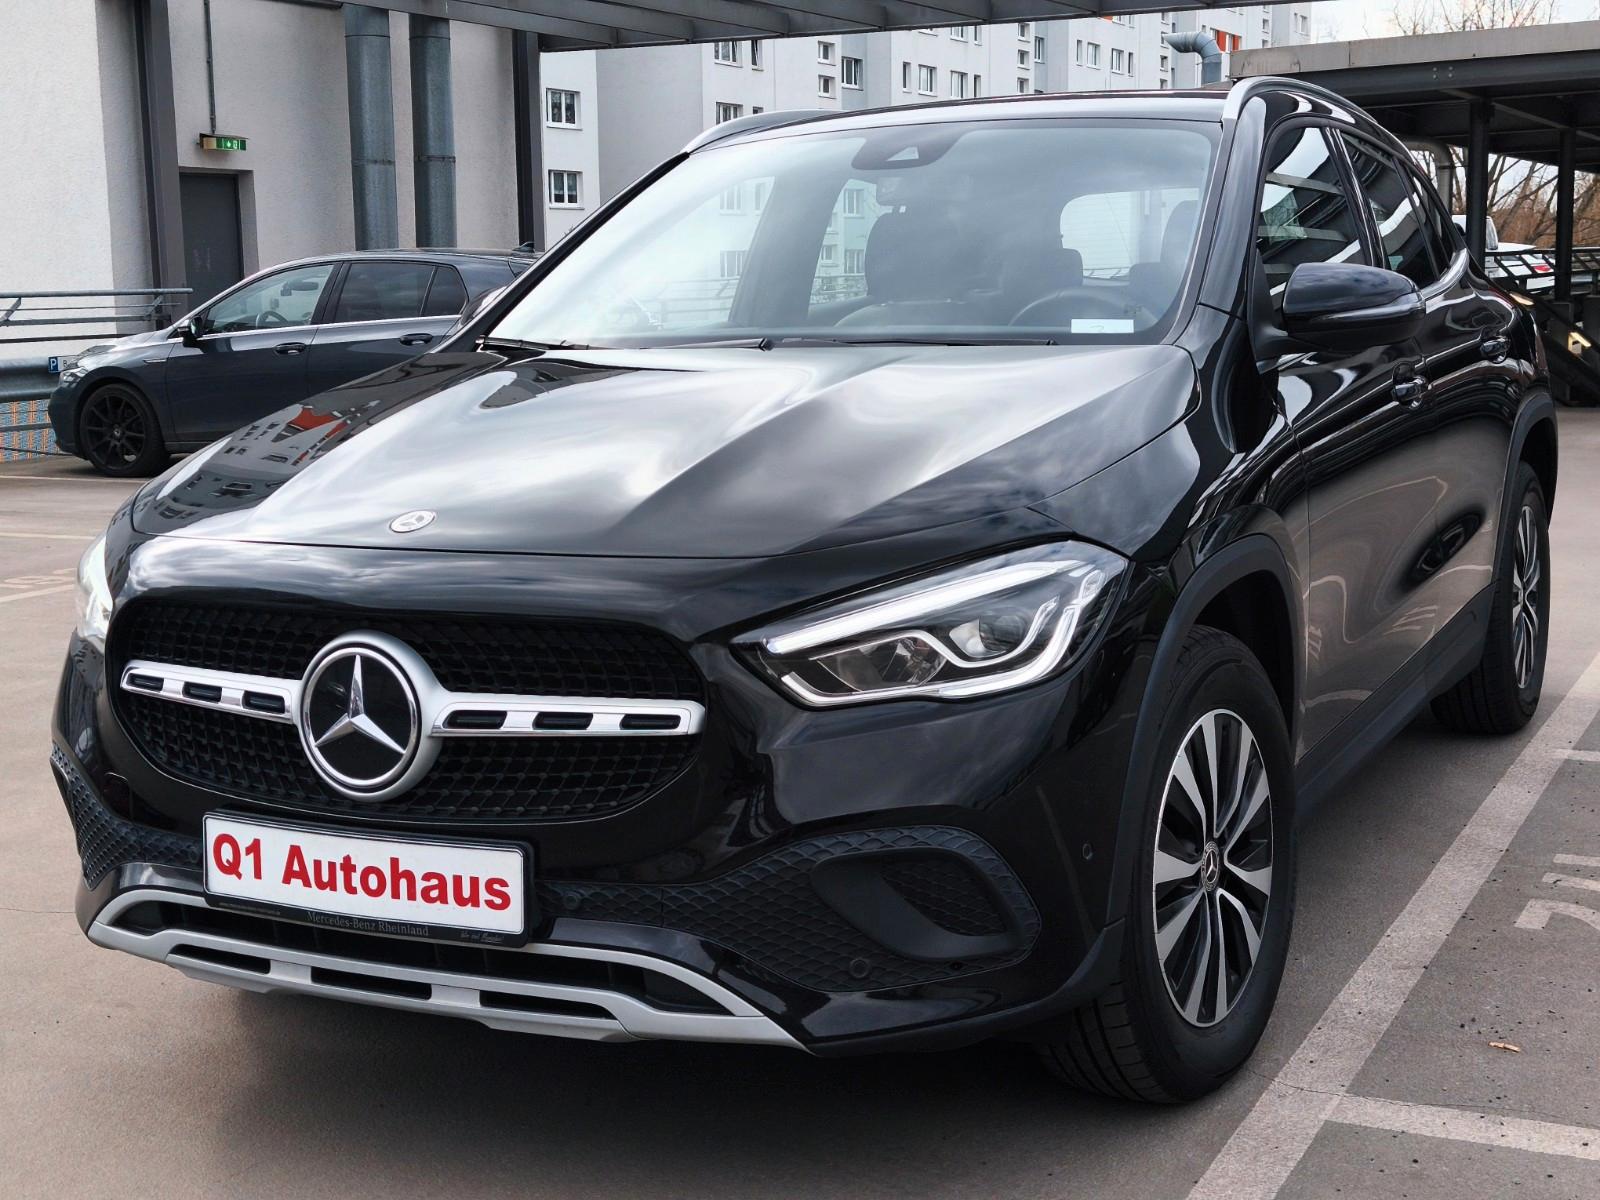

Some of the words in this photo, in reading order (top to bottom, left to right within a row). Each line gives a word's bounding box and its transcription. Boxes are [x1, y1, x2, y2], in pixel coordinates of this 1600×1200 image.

[213, 834, 263, 881] Q1
[282, 845, 512, 912] Autohaus
[306, 911, 376, 931] Mercedes-Benz
[378, 920, 429, 937] Rheinland
